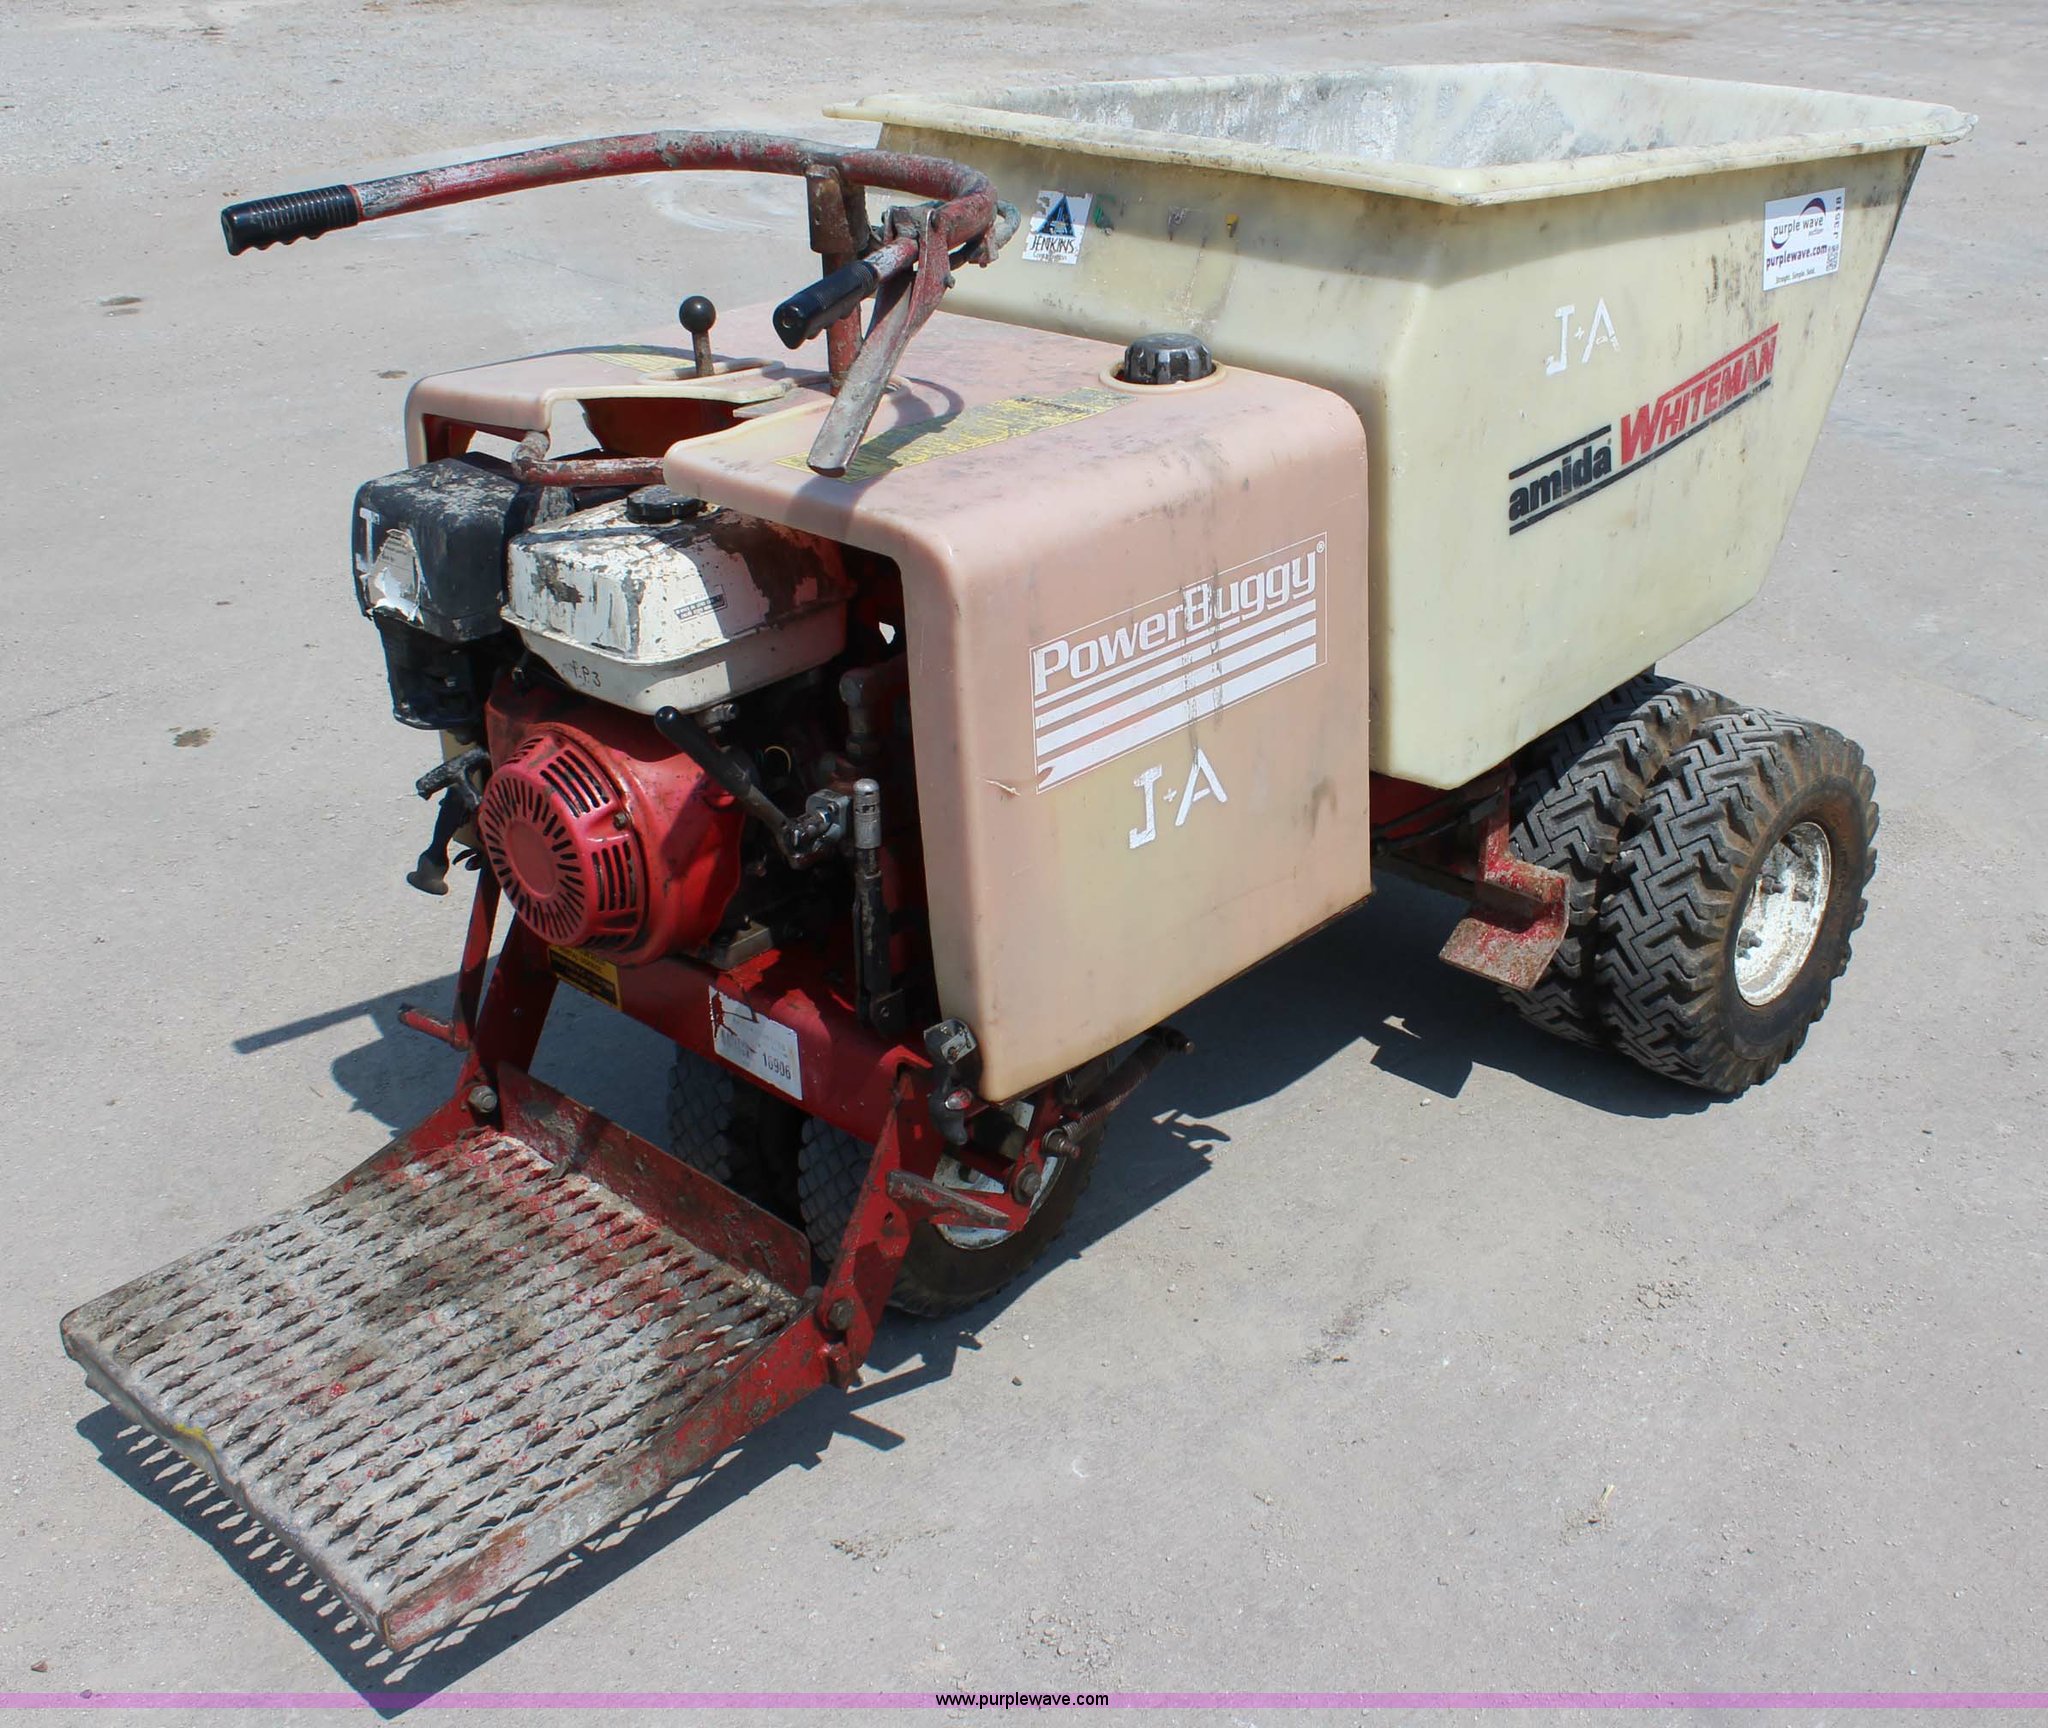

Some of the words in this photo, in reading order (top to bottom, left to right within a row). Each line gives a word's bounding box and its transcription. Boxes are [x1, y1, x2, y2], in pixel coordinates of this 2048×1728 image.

[1773, 219, 1801, 238] purple
[1803, 216, 1824, 230] wave
[1031, 234, 1075, 254] JENKINS
[1766, 244, 1828, 271] purplewave.com
[1509, 445, 1611, 521] amida
[1621, 335, 1777, 465] WHITEMAN
[1032, 548, 1317, 697] PowerBuggy
